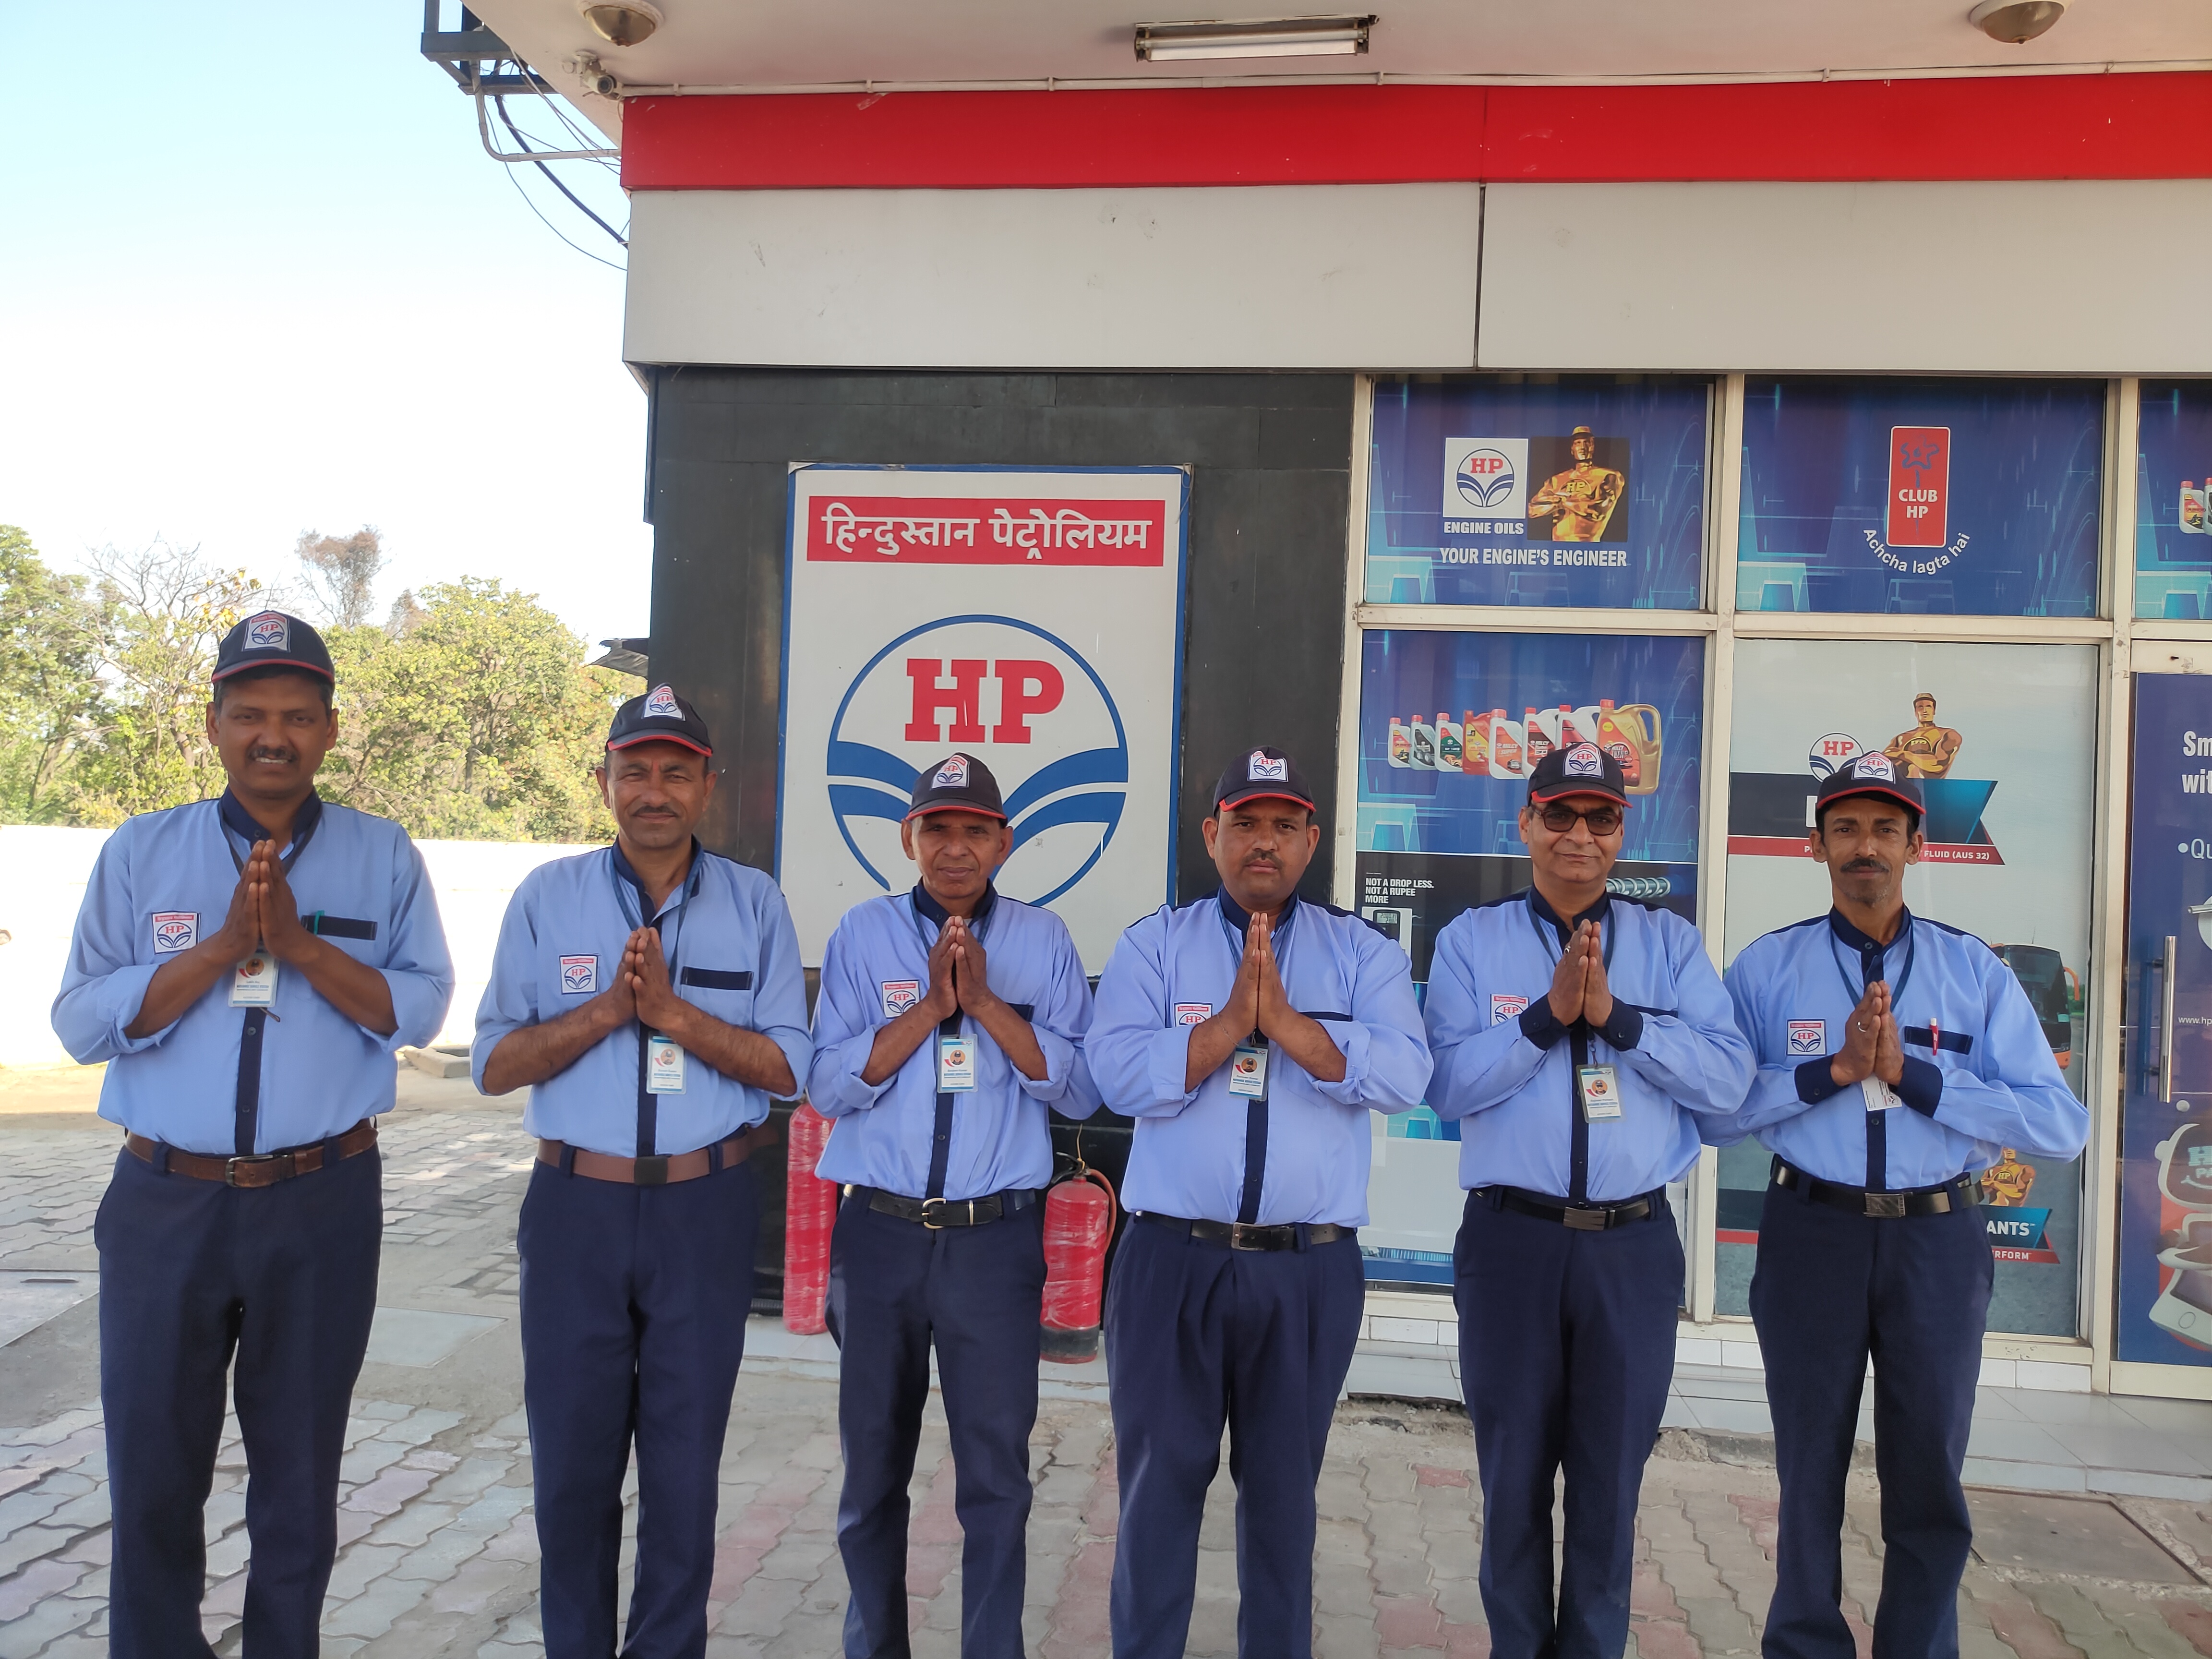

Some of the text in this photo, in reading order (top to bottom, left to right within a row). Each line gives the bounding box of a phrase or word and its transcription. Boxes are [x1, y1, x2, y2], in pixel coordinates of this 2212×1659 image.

[1470, 458, 1503, 474] HP
[1566, 481, 1586, 492] HP
[1898, 489, 1938, 502] CLUB
[1906, 505, 1928, 518] HP
[821, 502, 1153, 560] हिन्दुस्तान पेट्रोलियम
[1443, 521, 1524, 535] ENGINE OILS
[1440, 547, 1627, 567] YOUR ENGINE'S ENGINEER
[1863, 529, 1971, 575] Achcha lagta hai
[260, 624, 279, 633] HP
[905, 658, 1065, 744] HP
[1823, 741, 1854, 756] HP
[1924, 849, 1990, 861] FLUID (AUS 32)
[1365, 878, 1434, 889] NOT A DROP LESS.
[1365, 887, 1416, 897] NOT A RUPEE
[1365, 895, 1389, 904] MORE
[165, 925, 185, 934] HP
